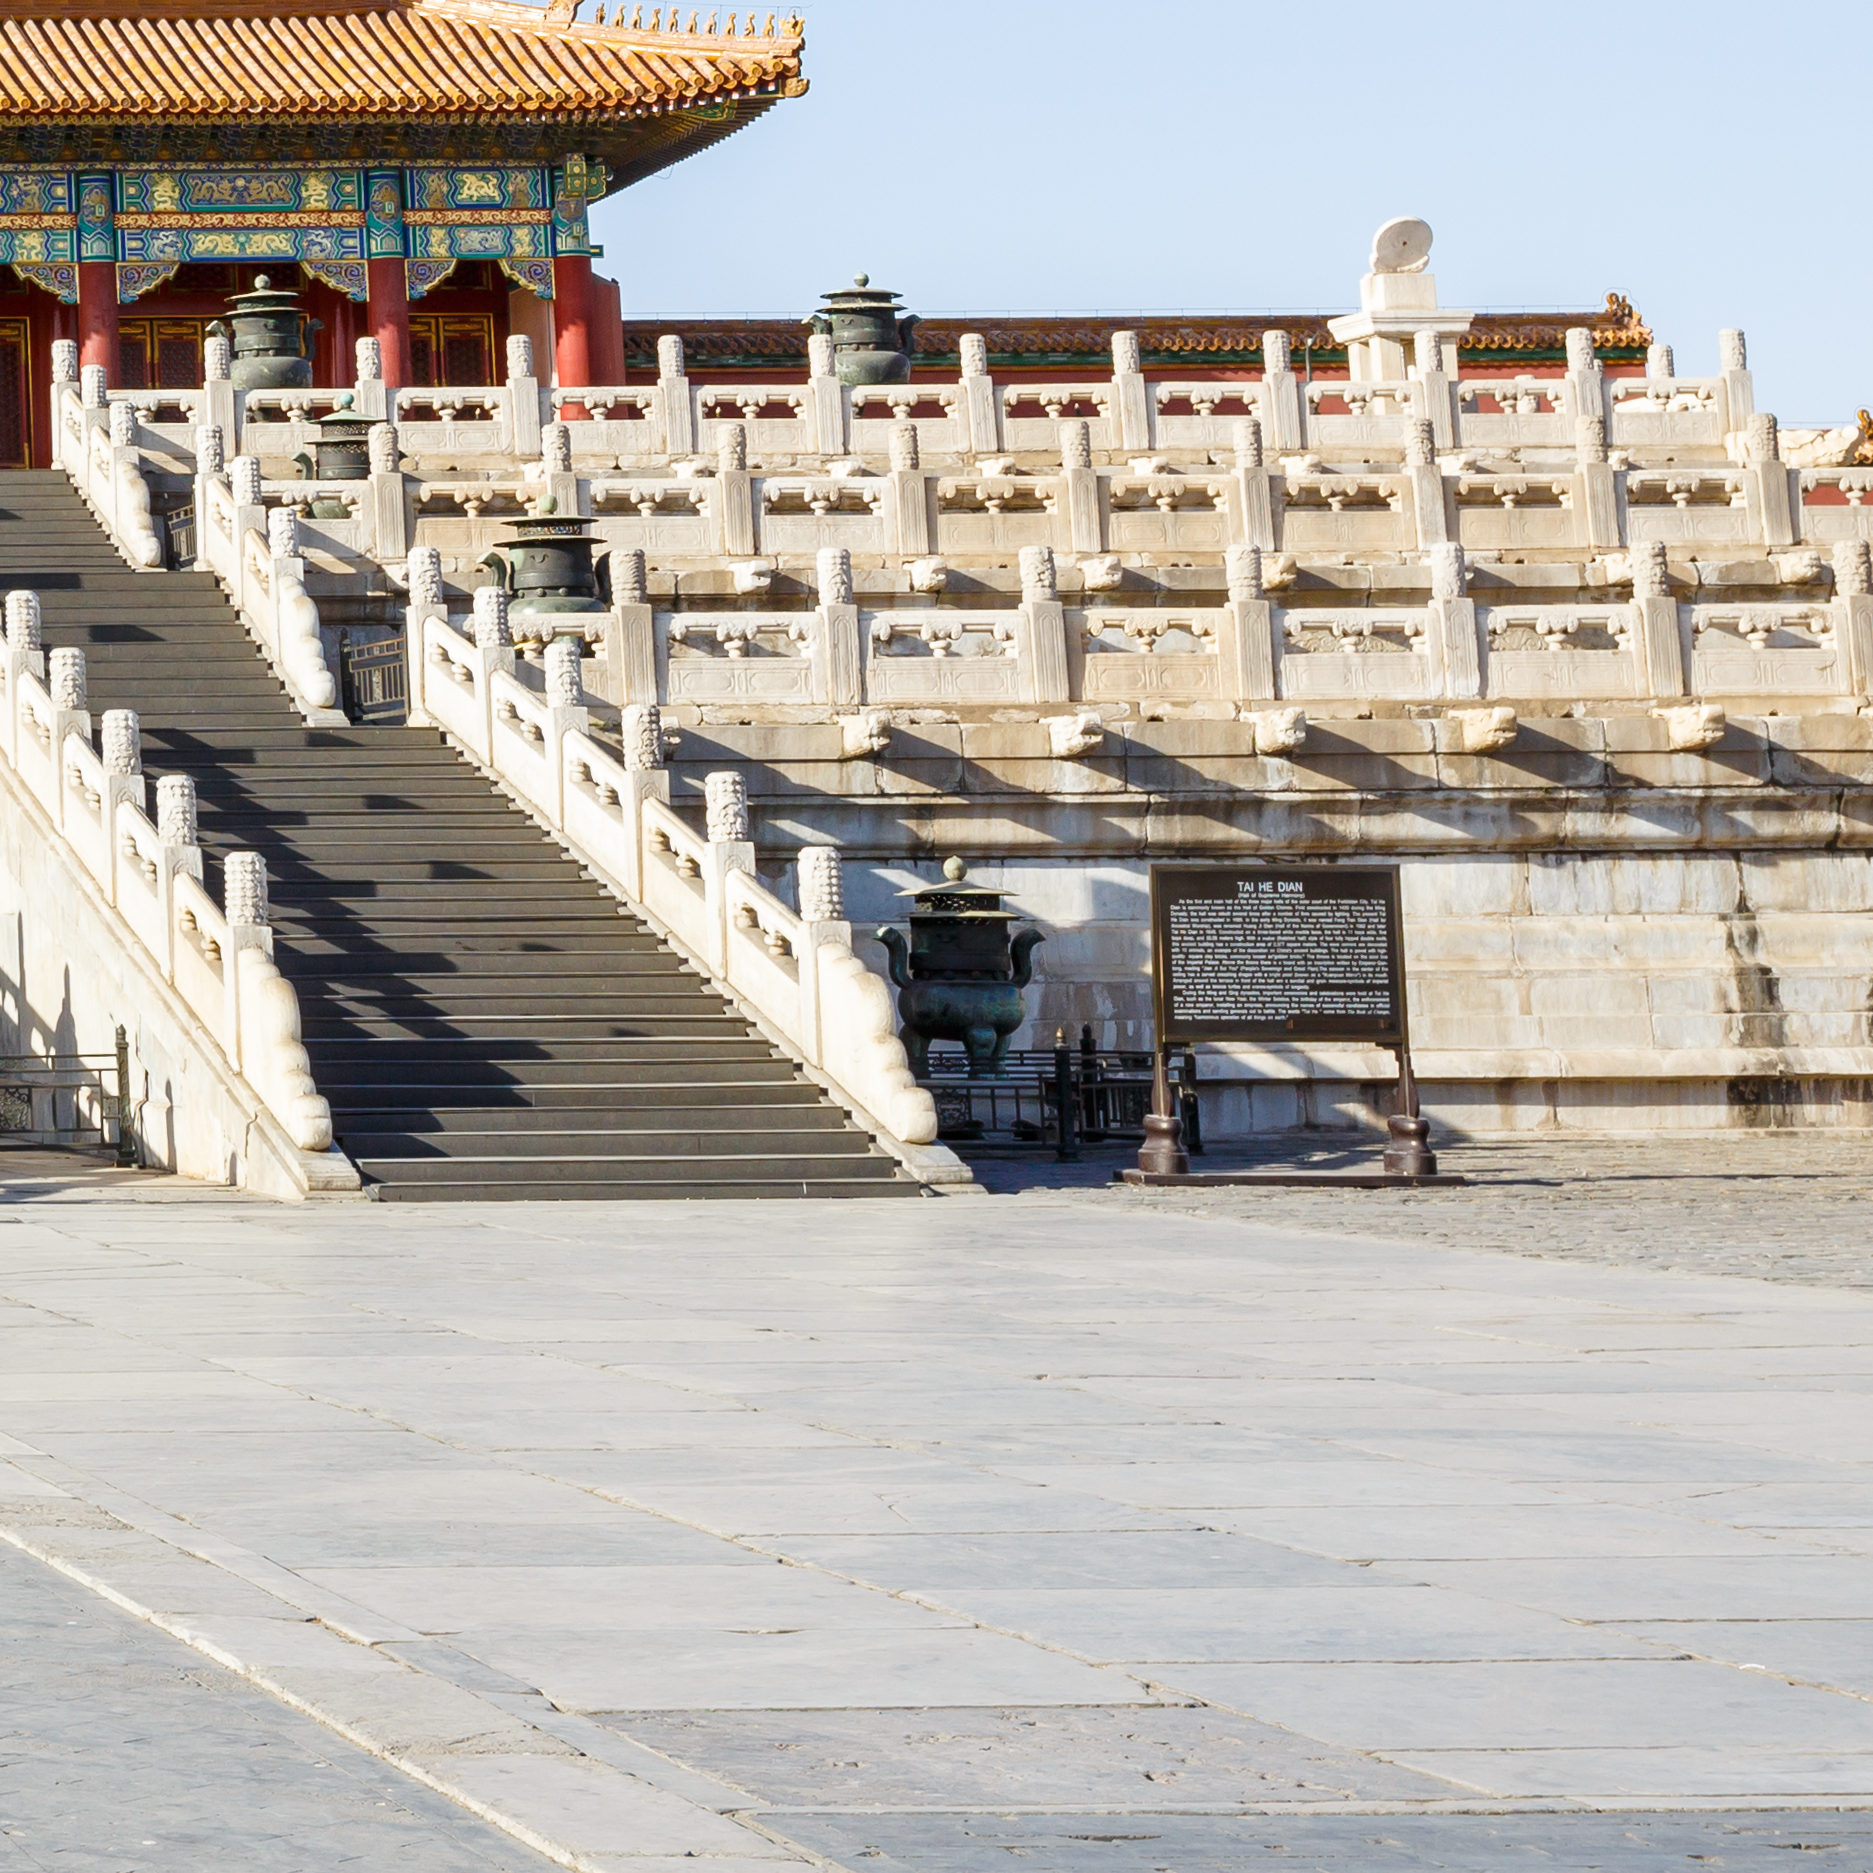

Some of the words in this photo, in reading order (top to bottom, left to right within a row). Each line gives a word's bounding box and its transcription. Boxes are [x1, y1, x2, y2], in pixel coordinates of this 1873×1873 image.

[1237, 881, 1254, 892] TAI
[1258, 881, 1274, 892] HE
[1277, 881, 1303, 892] DIAN
